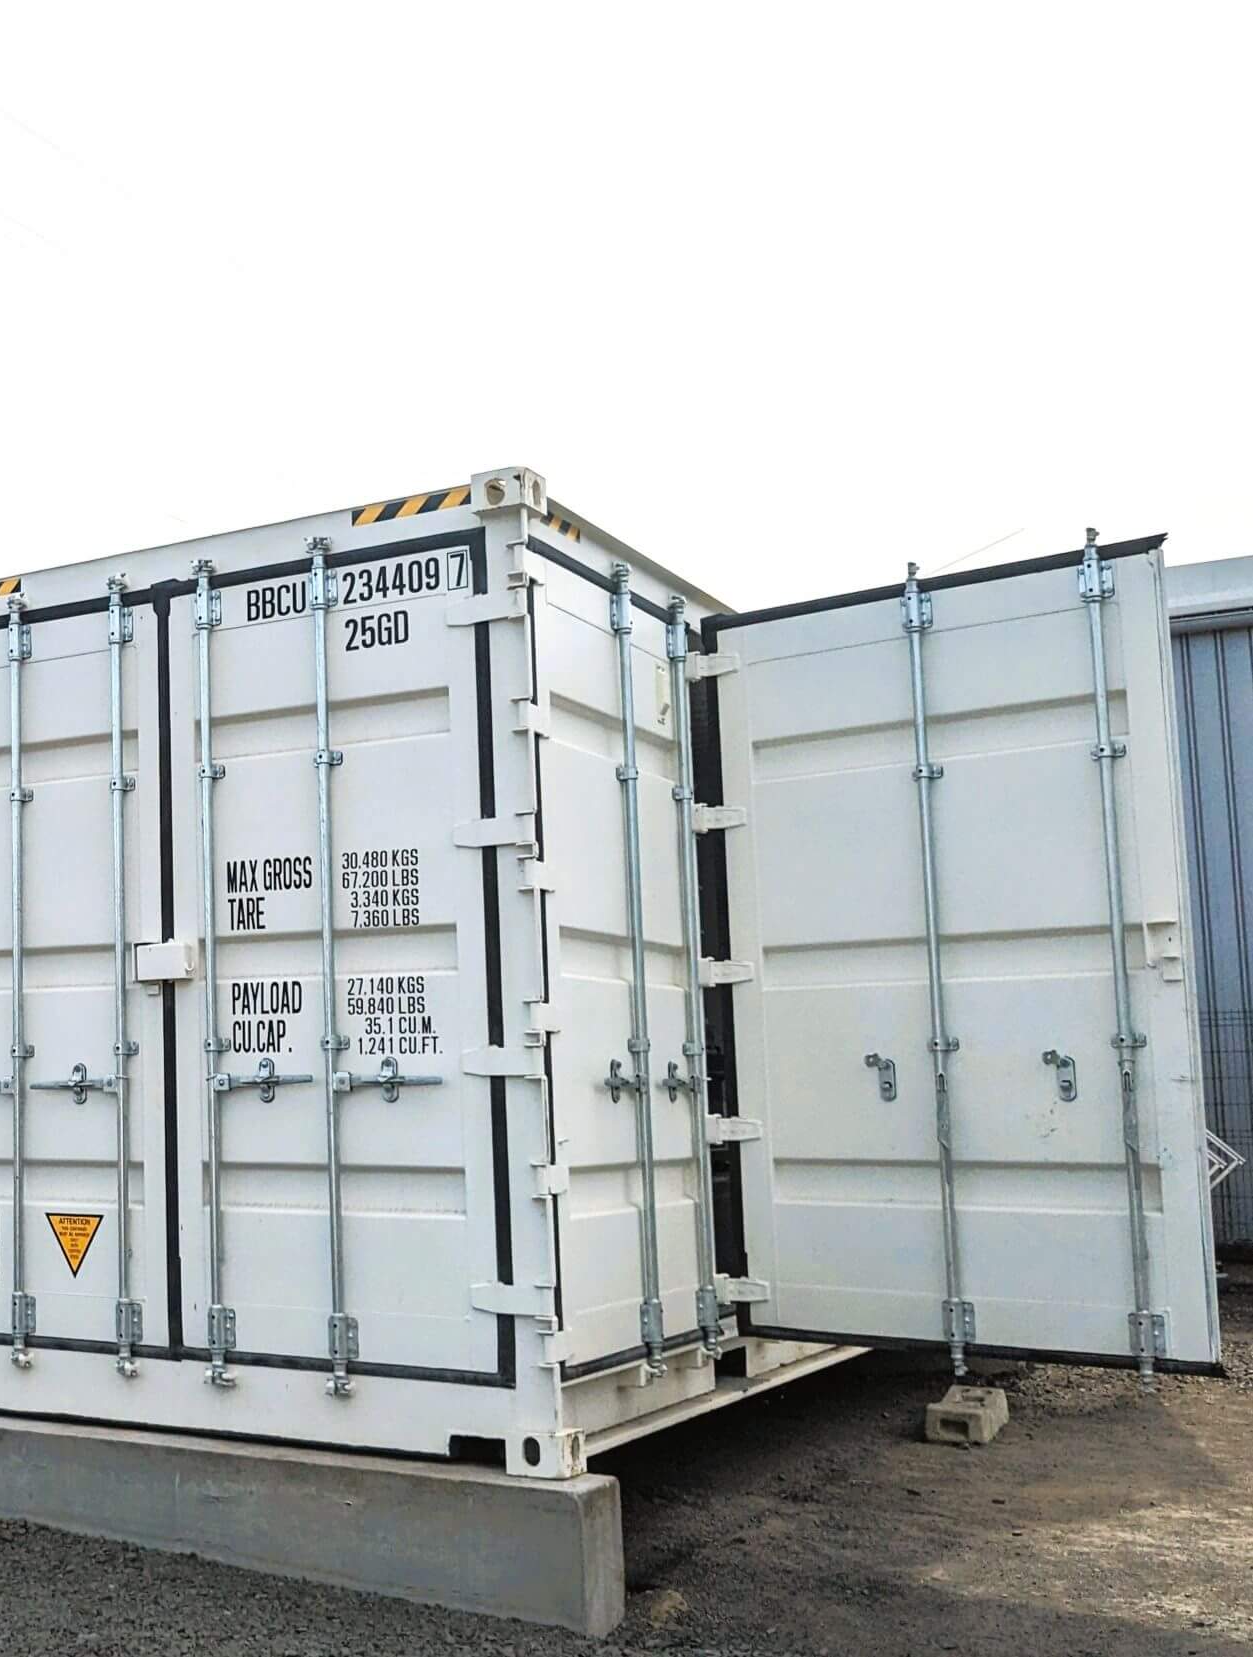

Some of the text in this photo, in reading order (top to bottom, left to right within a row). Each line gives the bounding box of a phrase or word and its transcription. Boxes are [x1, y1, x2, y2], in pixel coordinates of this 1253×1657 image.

[247, 554, 465, 621] BBCU 234409 7
[344, 610, 409, 652] 25GD
[341, 848, 419, 870] 30.480 KGS
[226, 855, 313, 894] MAX GROSS
[341, 868, 419, 889] 67.200 LBS
[350, 888, 419, 909] 3.340 KGS
[227, 896, 266, 931] TARE
[350, 908, 420, 929] 7.360 LBS
[347, 975, 425, 996] 27.140 KGS
[231, 980, 303, 1016] PAYLOAD
[347, 996, 426, 1016] 59.840 LBS
[364, 1016, 436, 1035] 35.1 CU.M.
[232, 1019, 293, 1054] CU.CAP.
[357, 1035, 443, 1055] 1.241 CU.FT.
[59, 1217, 91, 1225] ATTENTION
